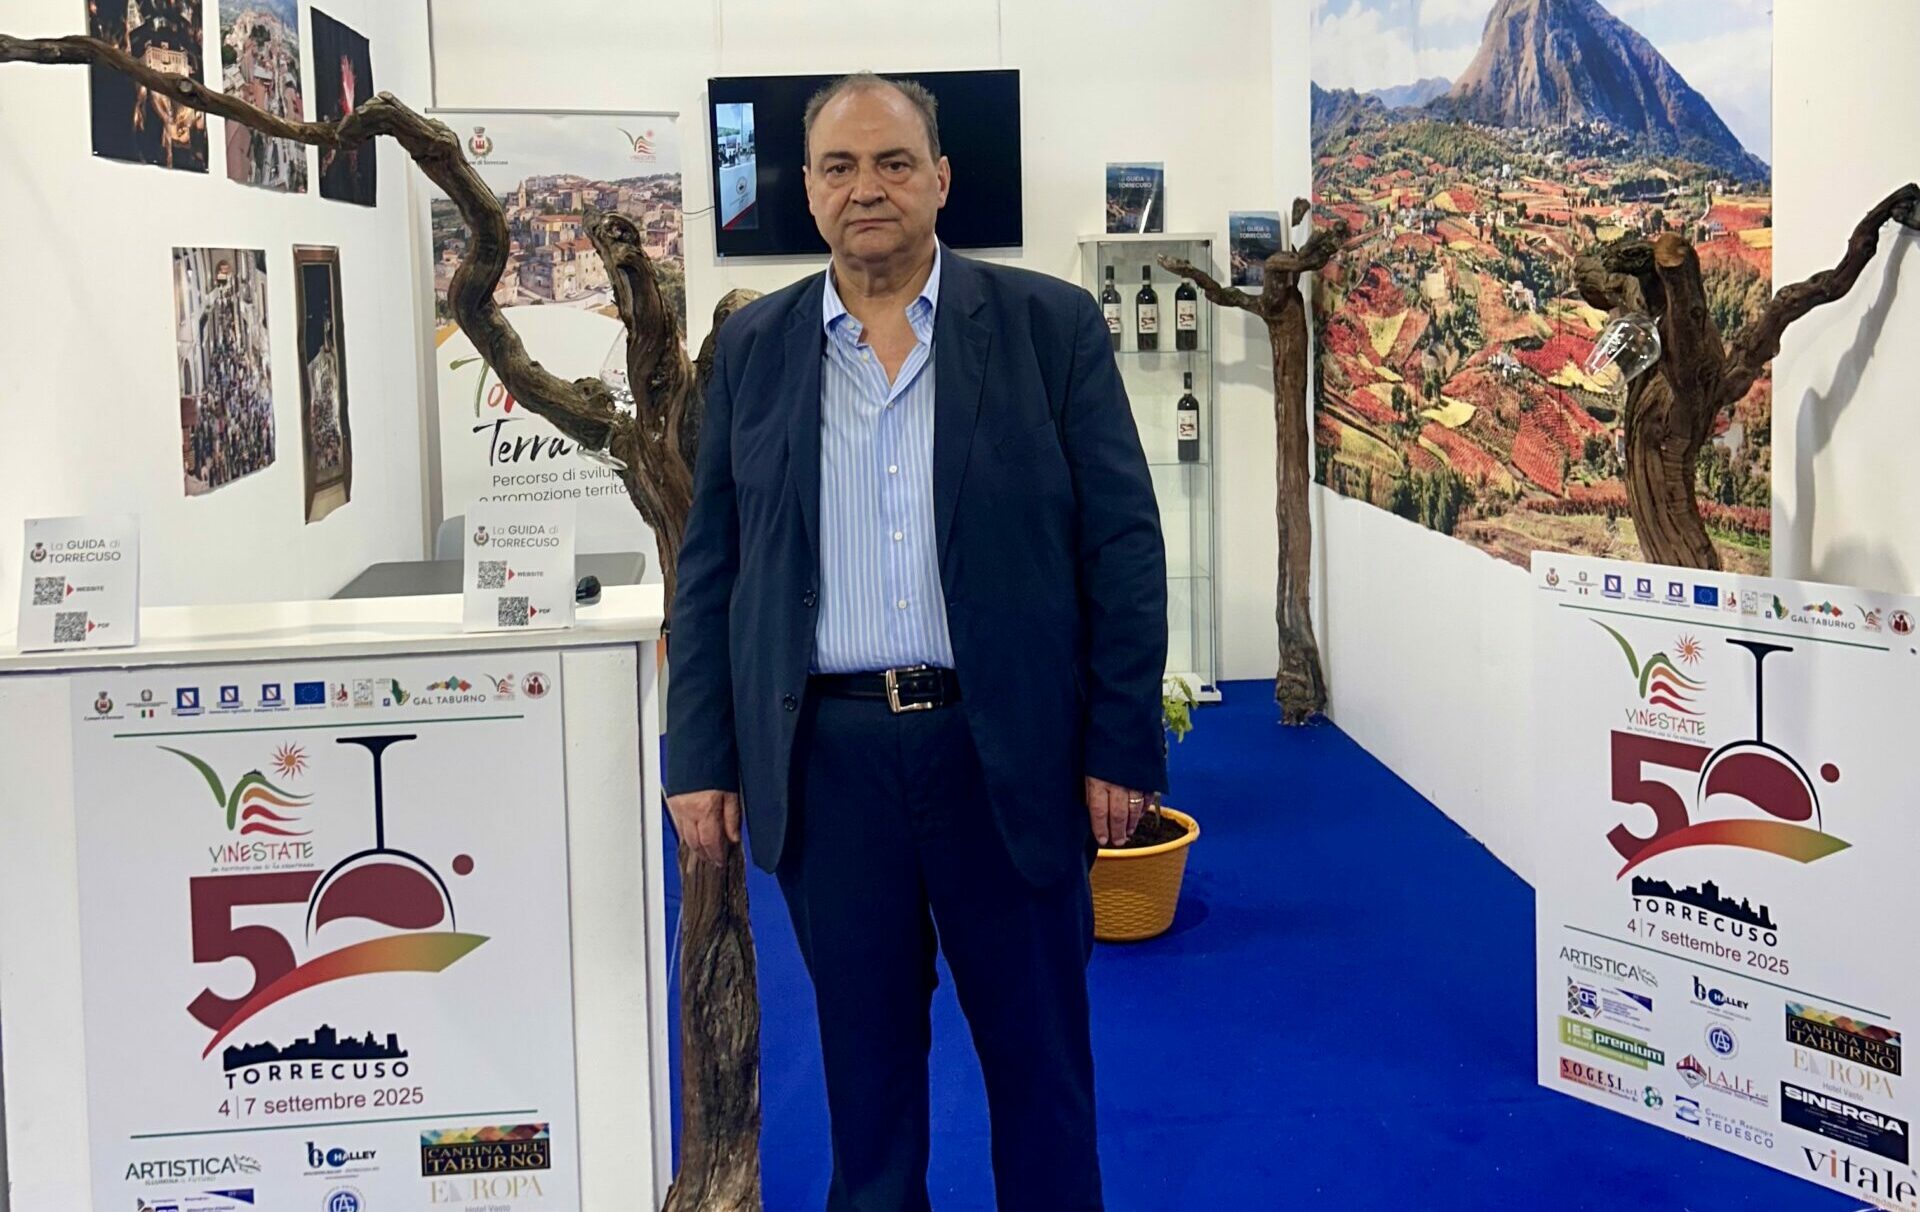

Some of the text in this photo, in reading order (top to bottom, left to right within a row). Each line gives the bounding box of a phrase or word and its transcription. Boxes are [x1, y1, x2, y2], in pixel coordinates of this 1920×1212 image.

[473, 417, 574, 467] Terra
[492, 471, 558, 487] Percorso
[562, 468, 576, 481] di
[490, 537, 560, 548] TORRECUSO
[508, 525, 545, 535] GUIDA
[48, 551, 122, 564] TORRECUSO
[66, 539, 106, 550] GUIDA
[1791, 613, 1809, 625] GAL
[1811, 617, 1856, 630] TABURNO
[413, 696, 433, 706] GAL
[436, 694, 487, 705] TABURNO
[1625, 708, 1706, 736] VINESTATE
[209, 841, 314, 864] VINESTATE
[1632, 898, 1778, 947] TORRECUSO
[1559, 946, 1640, 982] ARTISTICA
[1661, 929, 1742, 962] settembre
[1747, 950, 1790, 976] 2025
[1567, 1022, 1593, 1040] IES
[1595, 1032, 1662, 1062] premium
[1791, 1019, 1894, 1058] CANTINA DEL
[1792, 1028, 1895, 1070] TABURNO
[225, 1061, 410, 1090] TORRECUSO
[264, 1091, 367, 1115] settembre
[372, 1086, 425, 1107] 2025
[1784, 1086, 1904, 1136] SINERGIA
[1706, 1117, 1774, 1149] TEDESCO
[427, 1143, 541, 1158] CANTINA DEL
[428, 1153, 544, 1173] TABURNO
[125, 1155, 236, 1181] ARTISTICA
[1800, 1146, 1918, 1203] vitale
